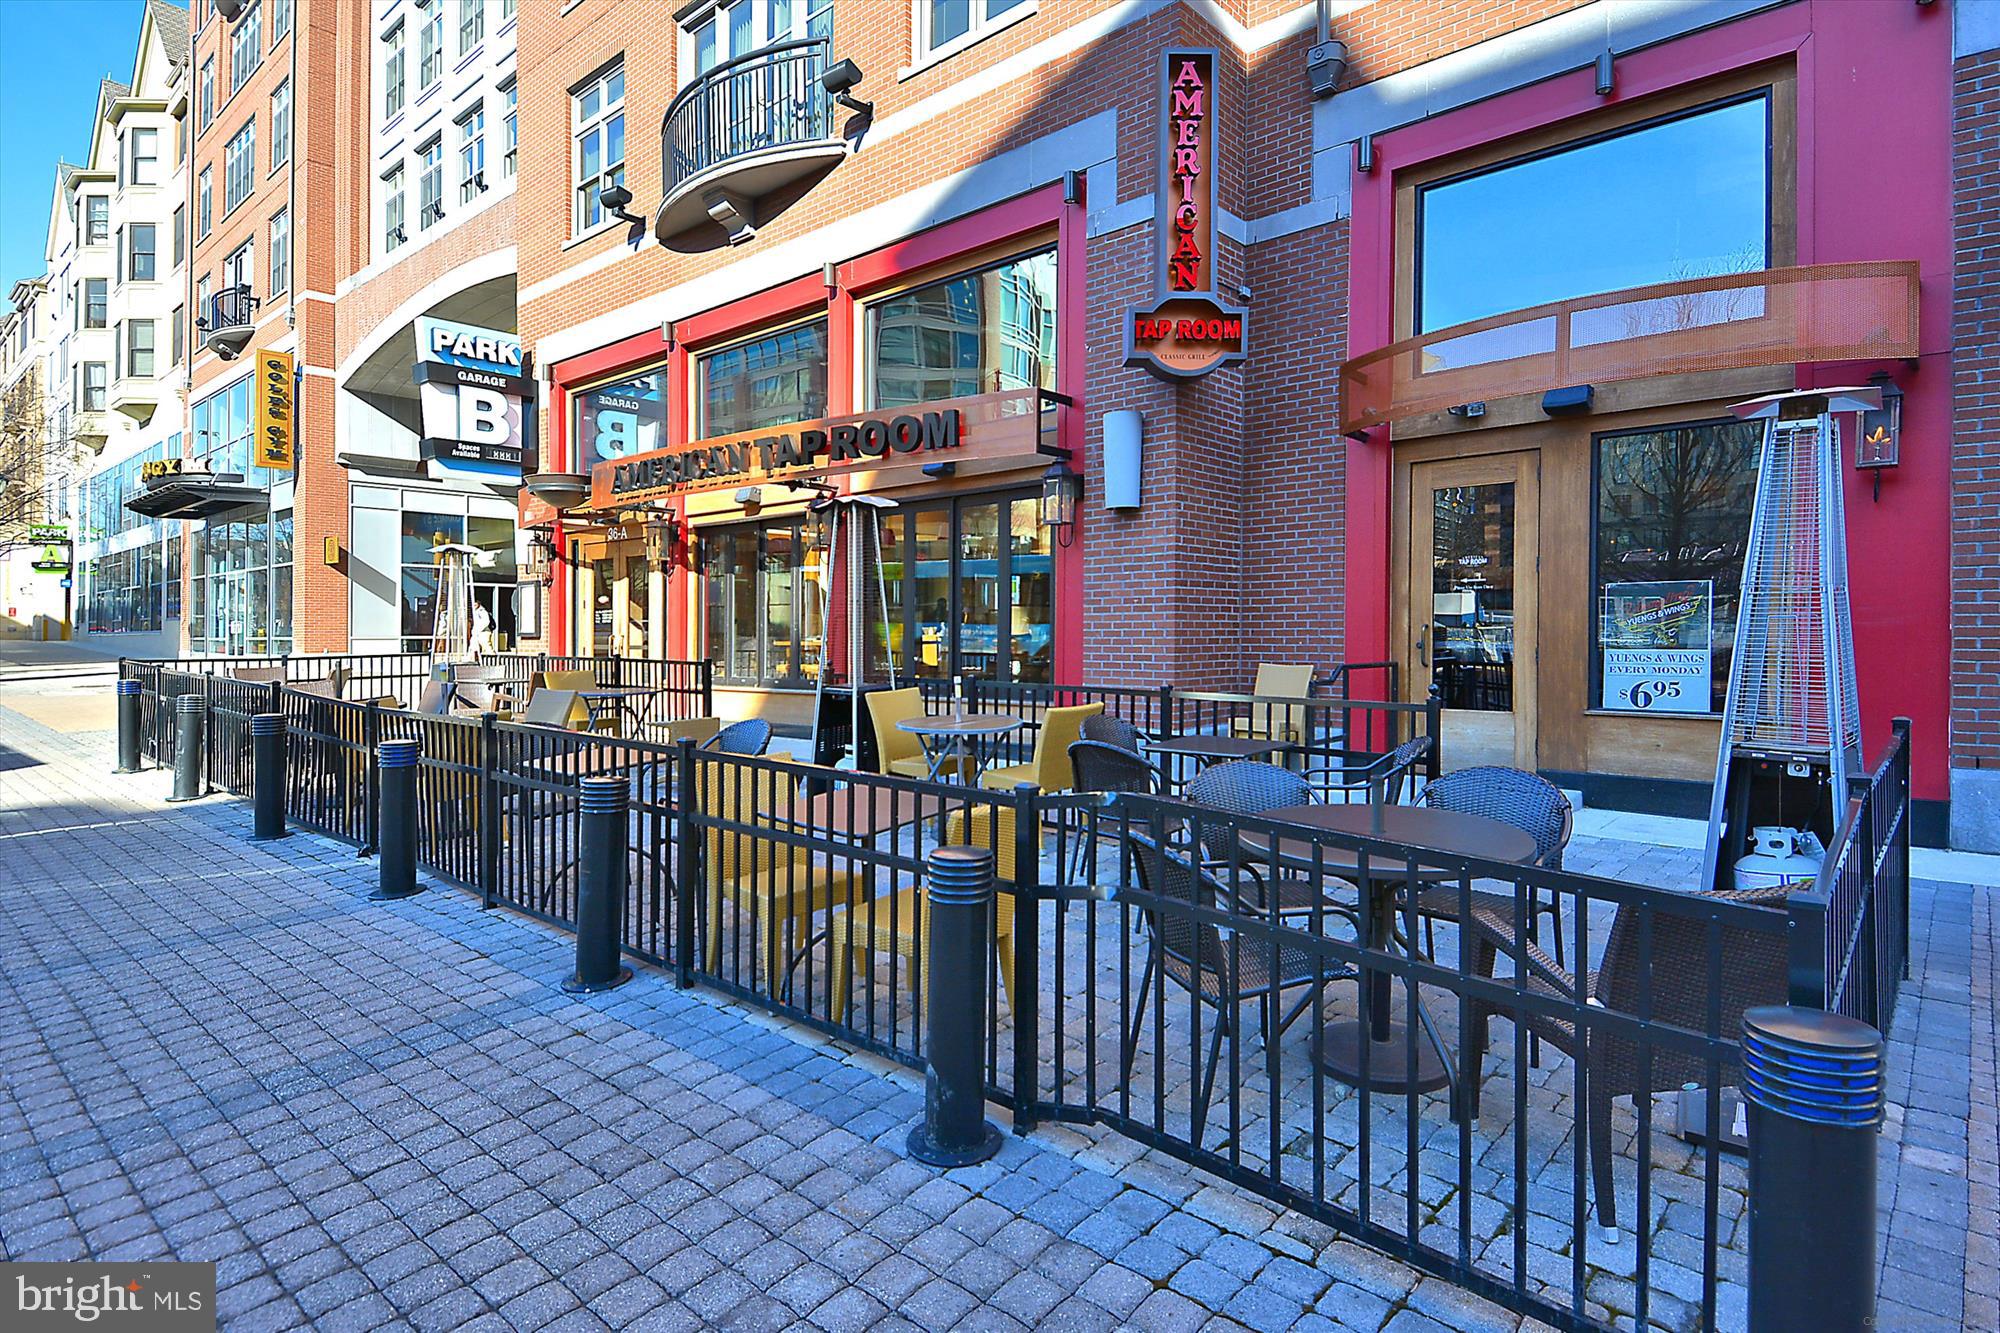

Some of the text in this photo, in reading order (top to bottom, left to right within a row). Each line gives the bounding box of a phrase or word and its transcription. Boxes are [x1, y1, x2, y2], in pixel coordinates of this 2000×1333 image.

[1173, 61, 1204, 291] AMERICAN
[1135, 319, 1241, 340] TAP ROOM
[431, 327, 522, 367] PARK
[457, 371, 507, 388] GARAGE
[459, 385, 511, 445] B
[451, 449, 481, 459] Available
[457, 442, 481, 452] Spaces
[611, 409, 960, 495] AMERICAN TAP ROOM
[1626, 612, 1657, 626] YUENGS
[1657, 610, 1664, 618] &
[1663, 602, 1691, 616] WINGS
[1609, 653, 1705, 663] YUENGS & WINGS
[1609, 666, 1703, 675] EVERY MONDAY
